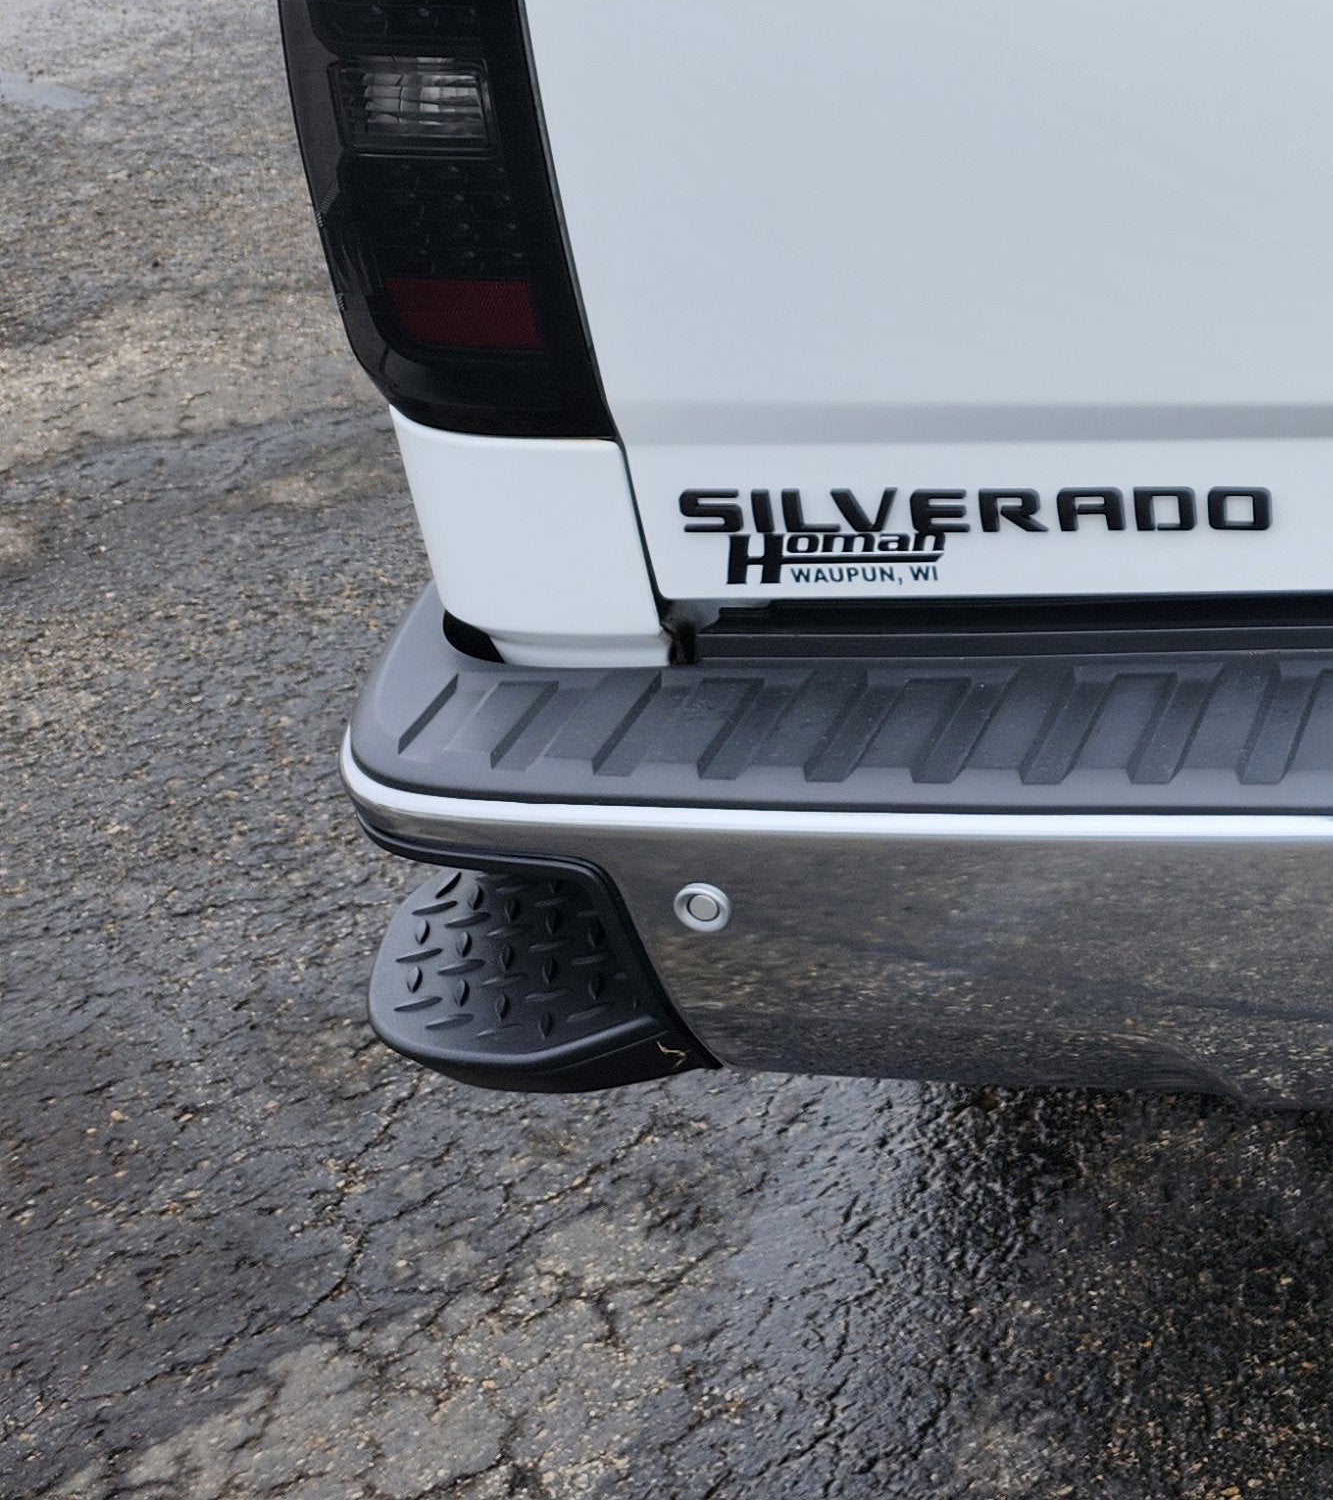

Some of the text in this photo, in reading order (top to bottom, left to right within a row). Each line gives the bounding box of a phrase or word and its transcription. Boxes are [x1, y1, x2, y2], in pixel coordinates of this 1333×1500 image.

[678, 485, 1272, 533] SILVERADO
[726, 533, 946, 585] Homan
[790, 565, 939, 586] WAUPUN, WI
